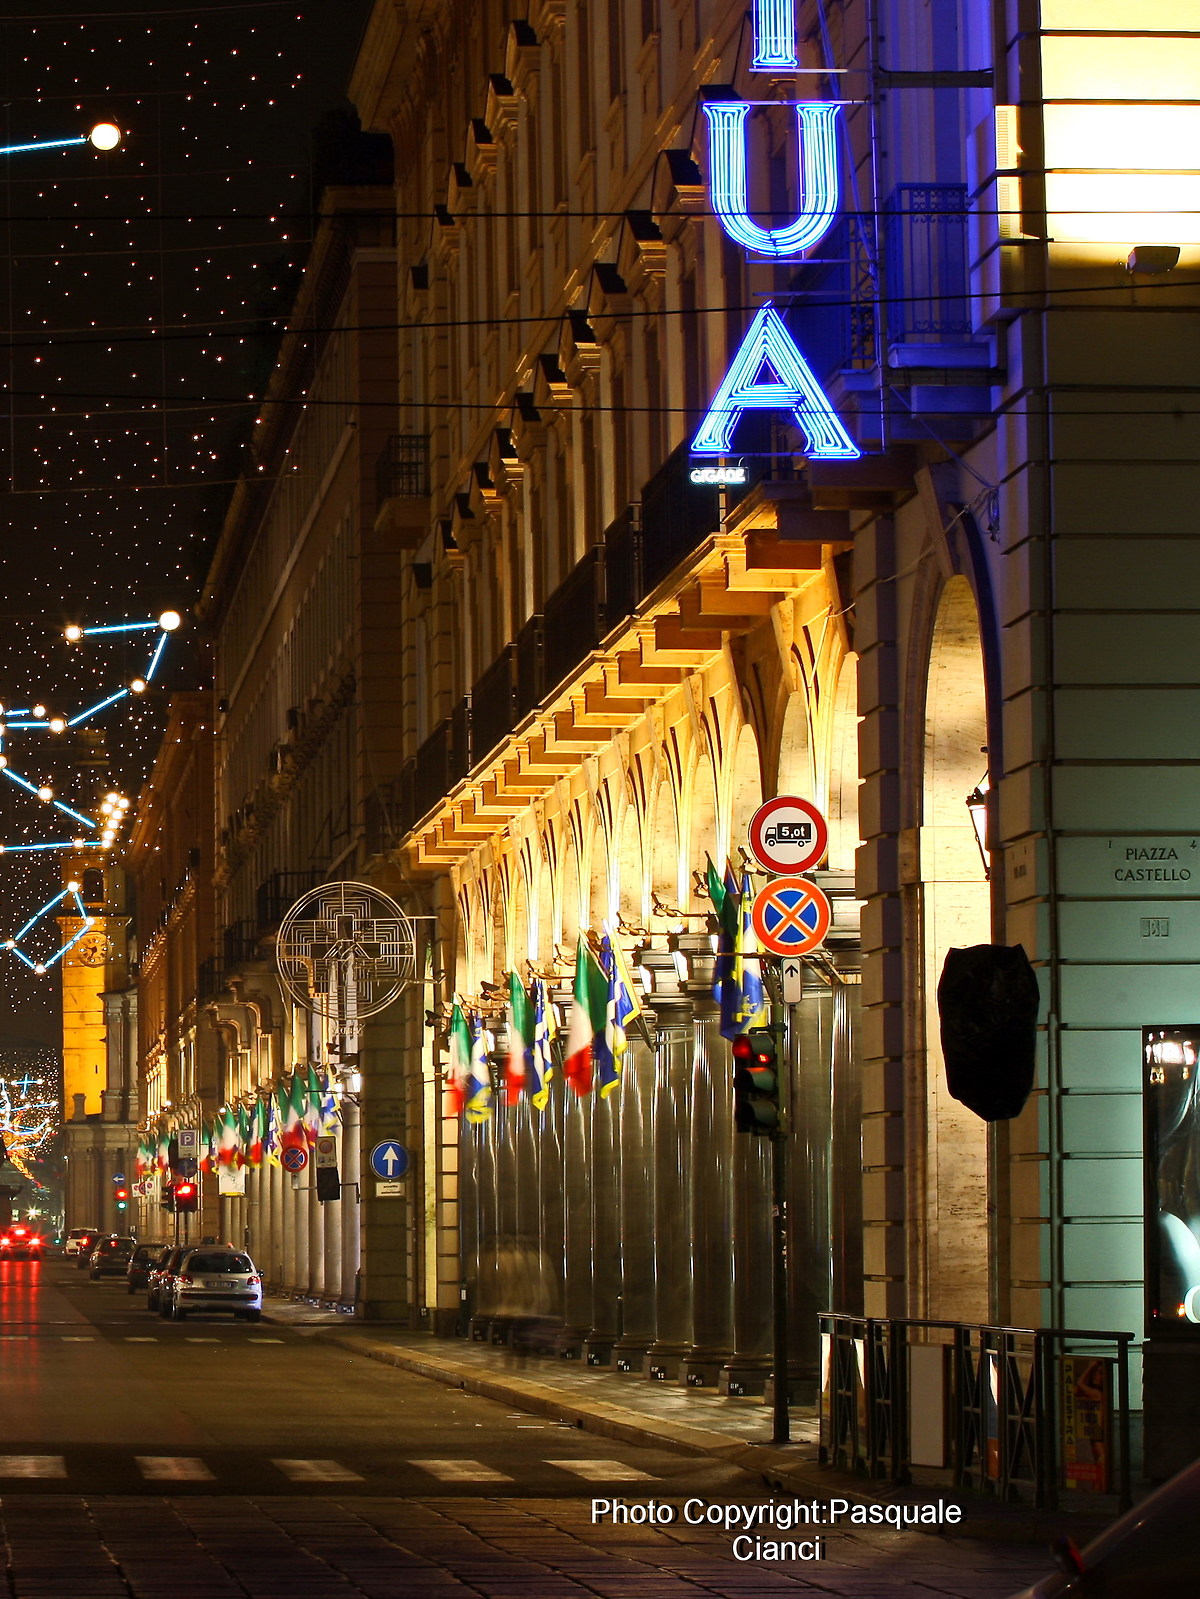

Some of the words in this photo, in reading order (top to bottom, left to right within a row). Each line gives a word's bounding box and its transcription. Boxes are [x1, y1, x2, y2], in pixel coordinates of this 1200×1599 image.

[1125, 847, 1179, 861] PIAZZA
[1114, 868, 1192, 882] CASTELLO
[1063, 1364, 1074, 1445] PALESTRA
